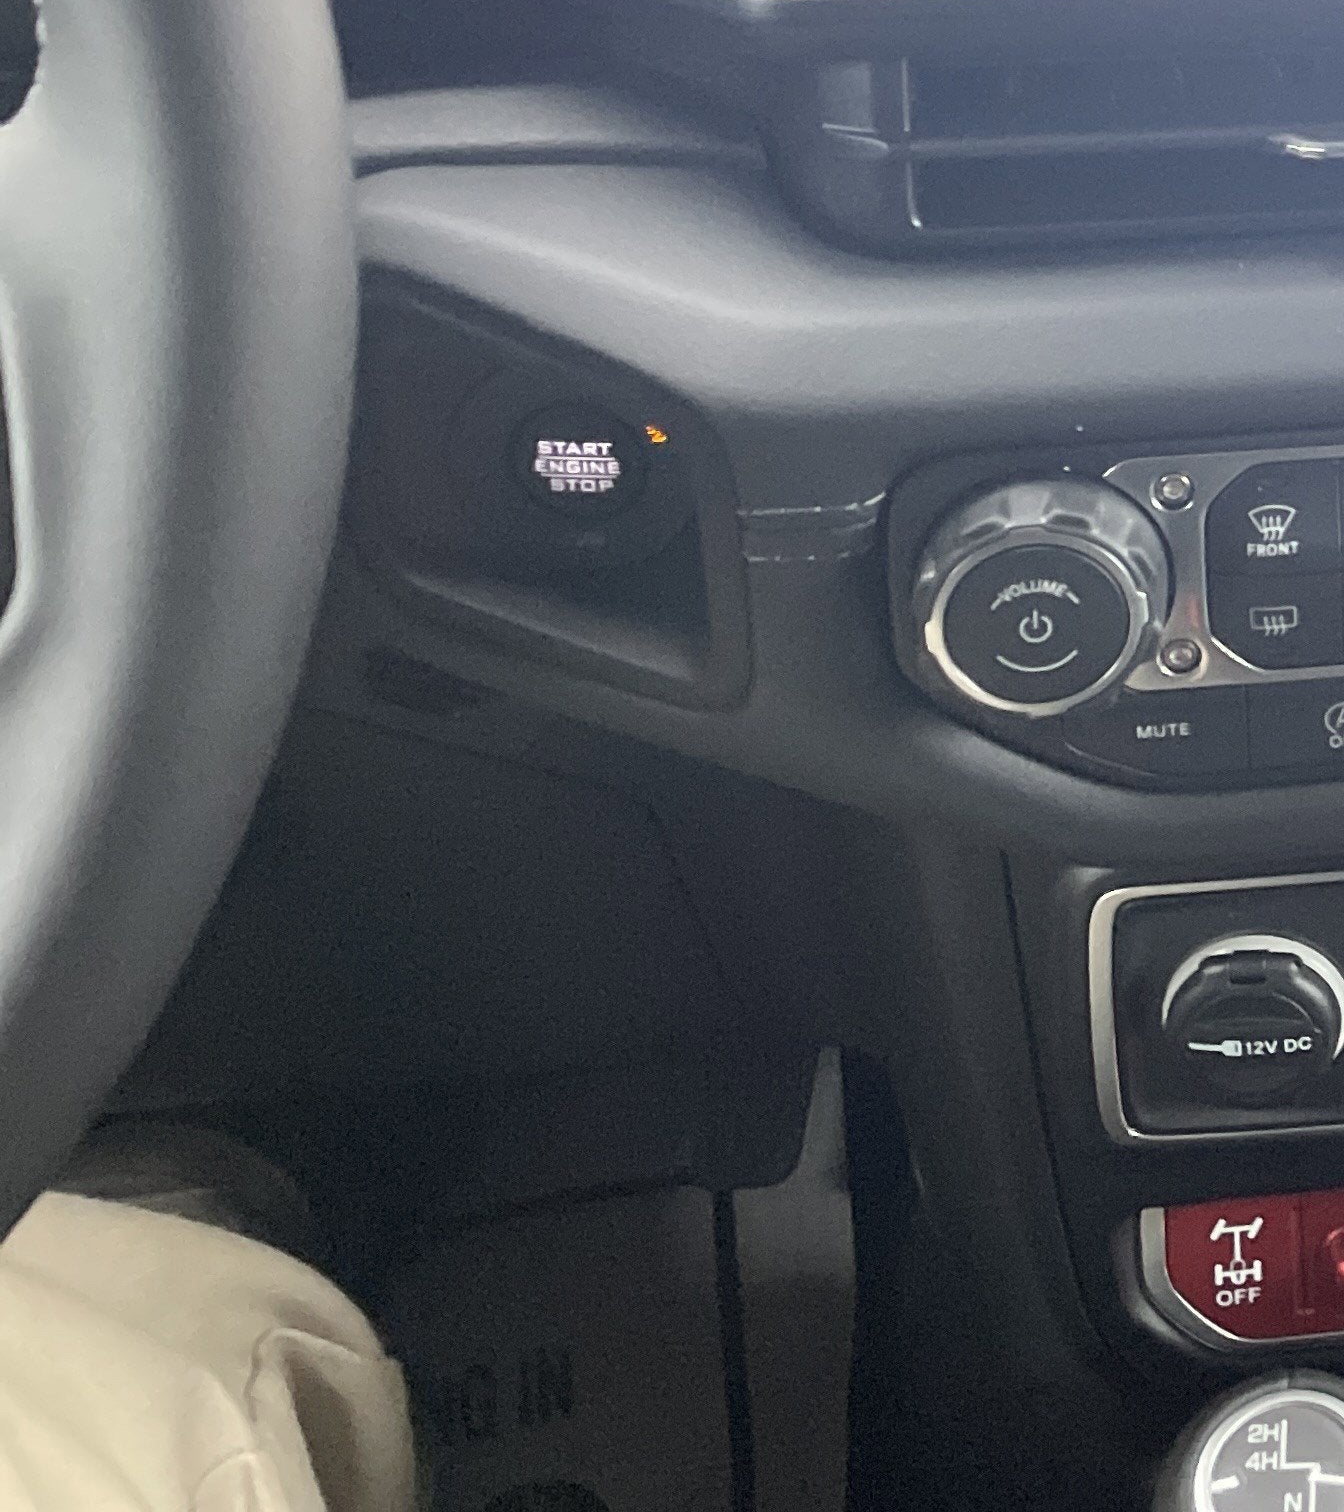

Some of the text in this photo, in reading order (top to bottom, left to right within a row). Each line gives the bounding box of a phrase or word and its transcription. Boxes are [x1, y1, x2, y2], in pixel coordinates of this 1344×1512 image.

[537, 440, 613, 456] START
[534, 458, 621, 475] ENGINE
[550, 478, 615, 493] STOP
[1246, 541, 1300, 557] FRONT
[998, 578, 1067, 602] VOLUME
[1136, 721, 1191, 740] MUTE
[1244, 1037, 1312, 1056] 12V DC
[1215, 1287, 1262, 1307] OFF
[1247, 1422, 1280, 1443] 2H
[1245, 1450, 1279, 1472] 4H
[1284, 1491, 1303, 1512] N
